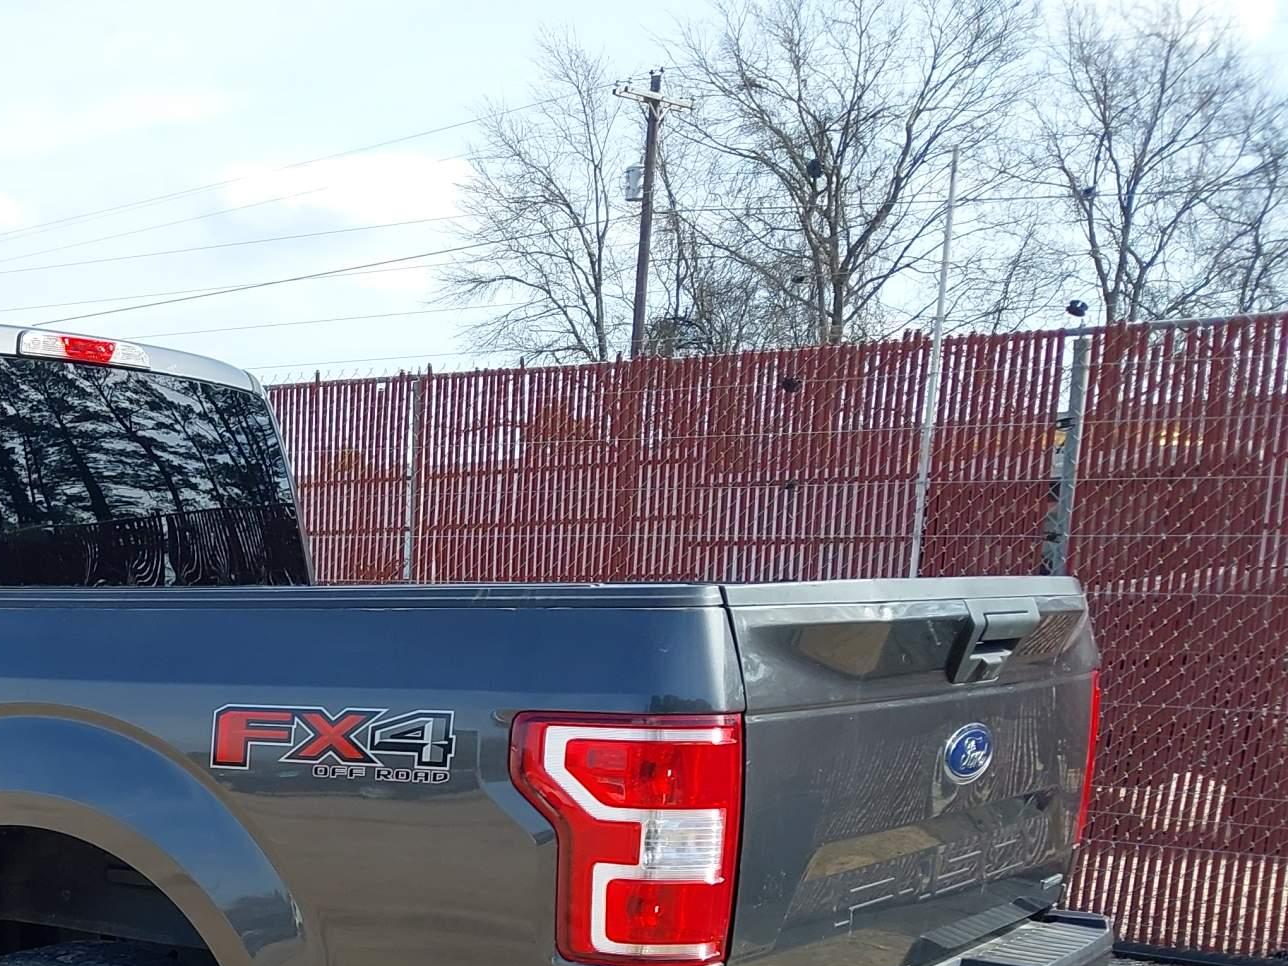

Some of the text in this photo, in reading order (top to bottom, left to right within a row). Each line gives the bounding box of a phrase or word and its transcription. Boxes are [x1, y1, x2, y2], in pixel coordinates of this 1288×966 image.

[210, 704, 455, 769] FX4
[312, 765, 450, 783] OFF ROAD
